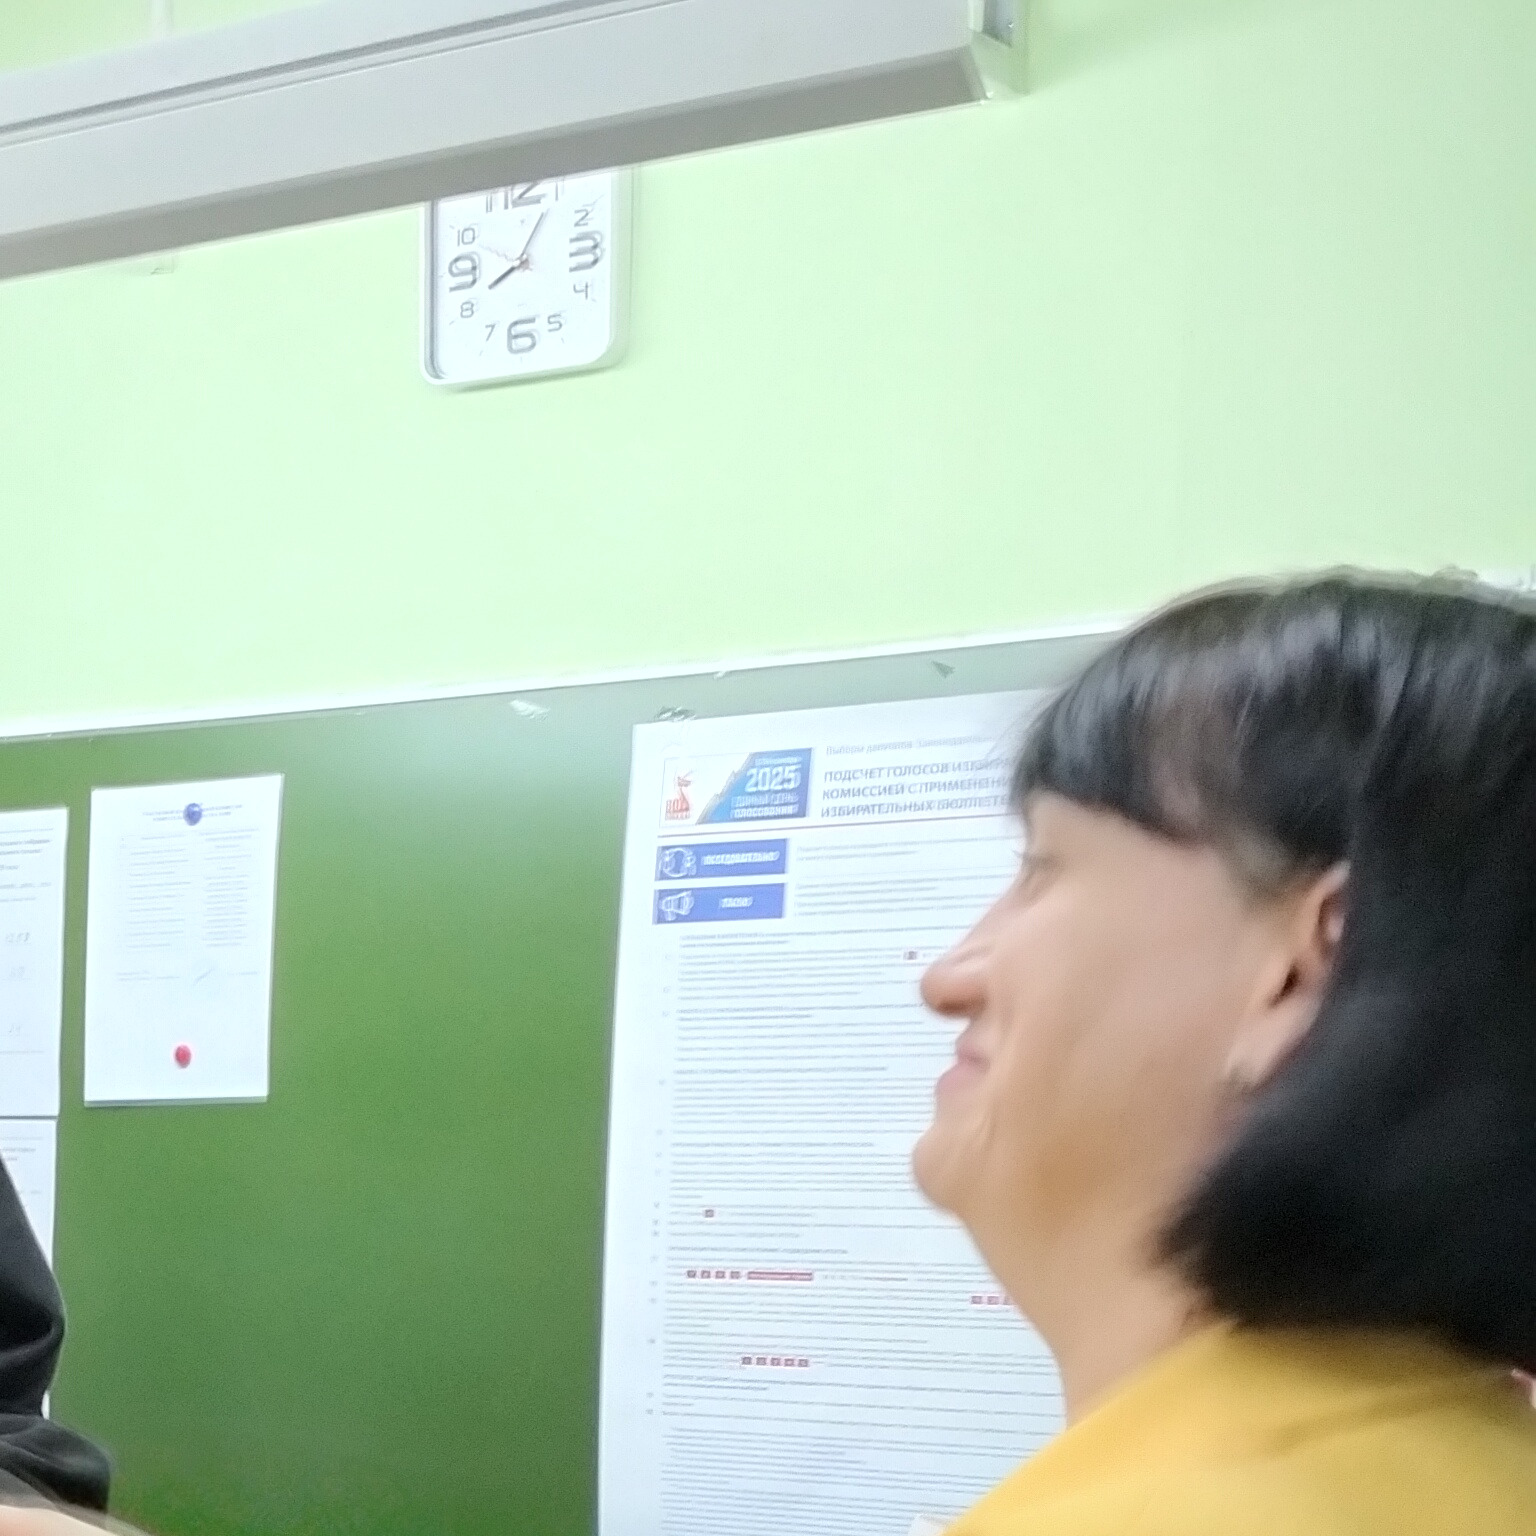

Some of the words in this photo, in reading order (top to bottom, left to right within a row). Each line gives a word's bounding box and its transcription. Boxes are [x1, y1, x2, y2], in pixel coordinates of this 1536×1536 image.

[574, 208, 590, 227] 2
[457, 227, 476, 247] 10
[569, 231, 601, 273] 3
[448, 253, 478, 293] 9
[573, 281, 589, 300] 4
[460, 301, 475, 319] 8
[547, 314, 563, 332] 5
[485, 324, 496, 342] 7
[506, 317, 537, 355] 6
[745, 764, 802, 793] 2025
[824, 767, 882, 783] ПОДСЧЕТ
[886, 762, 949, 779] ГОЛОСОВ
[822, 783, 905, 800] КОМИССИЕЙ
[908, 781, 917, 794] С
[820, 802, 933, 818] ИЗБИРАТЕЛЬНЫХ
